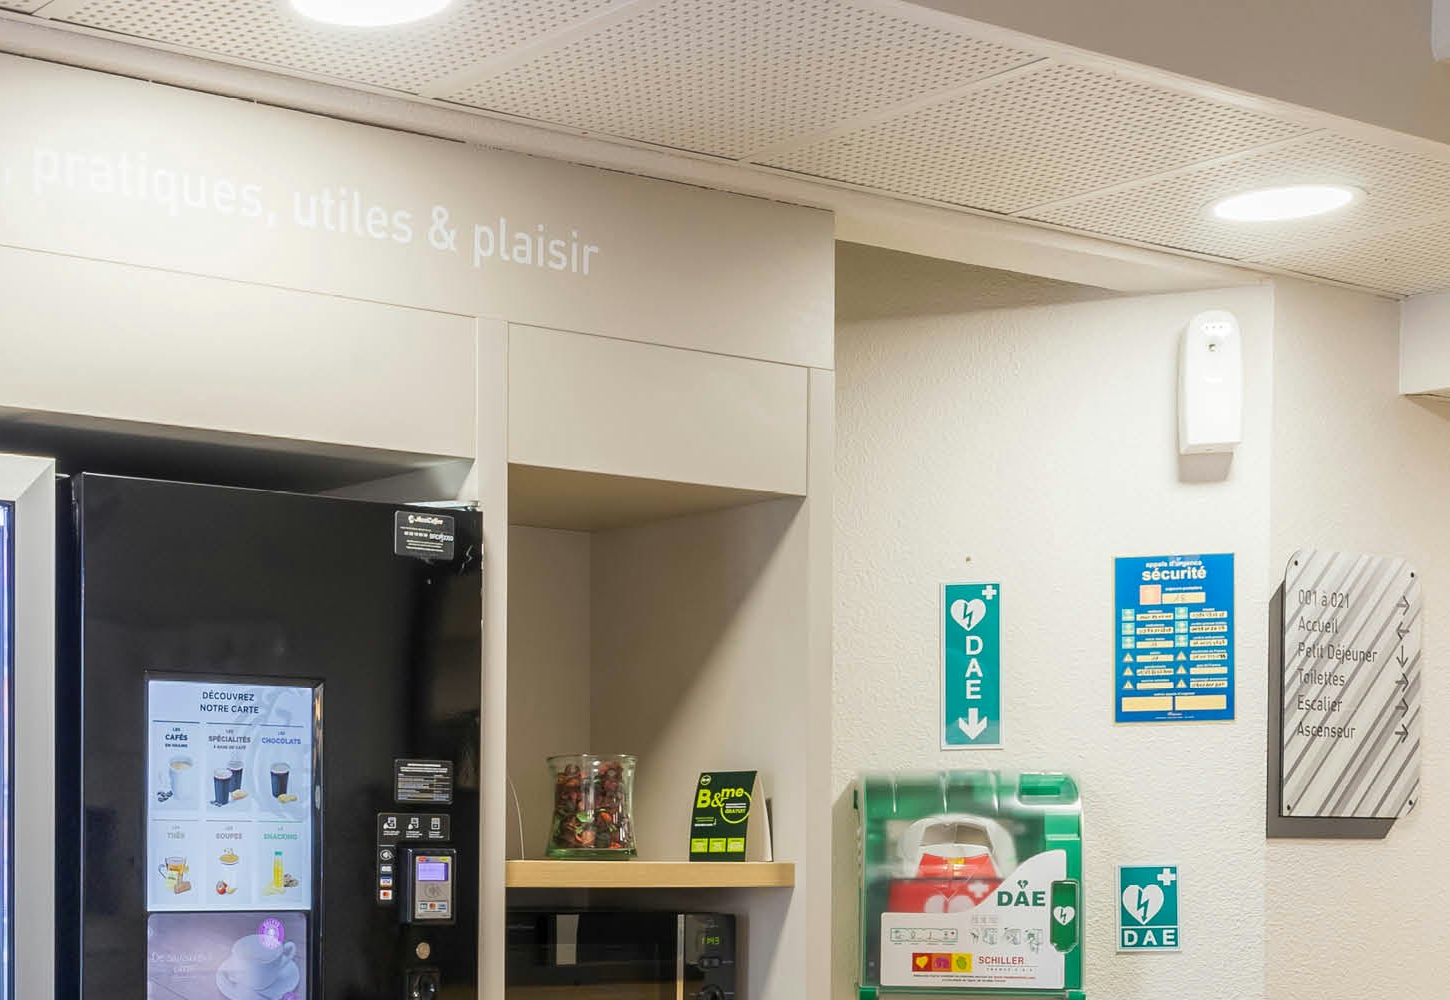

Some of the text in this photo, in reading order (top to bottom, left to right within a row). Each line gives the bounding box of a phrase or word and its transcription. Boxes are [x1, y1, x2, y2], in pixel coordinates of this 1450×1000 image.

[32, 147, 277, 229] pratiques,
[293, 186, 414, 244] utiles
[426, 205, 457, 252] &
[472, 217, 599, 275] plaisir
[1142, 565, 1207, 582] sécurité
[1298, 589, 1351, 609] 001 à 021
[1298, 616, 1339, 634] Accueil
[1298, 642, 1378, 664] Petit Déjeuner
[965, 635, 983, 700] DAE
[1298, 667, 1345, 687] Toilettes
[202, 689, 255, 702] DÉCOUVREZ
[1297, 694, 1342, 712] Escalier
[200, 704, 260, 714] NOTRE CARTE
[165, 732, 188, 741] CAFÉS
[1297, 720, 1356, 739] Ascenseur
[208, 735, 251, 743] SPÉCIALITÉS
[997, 891, 1046, 907] DAE
[1123, 929, 1176, 946] DAE
[978, 956, 1024, 965] SCHILLER
